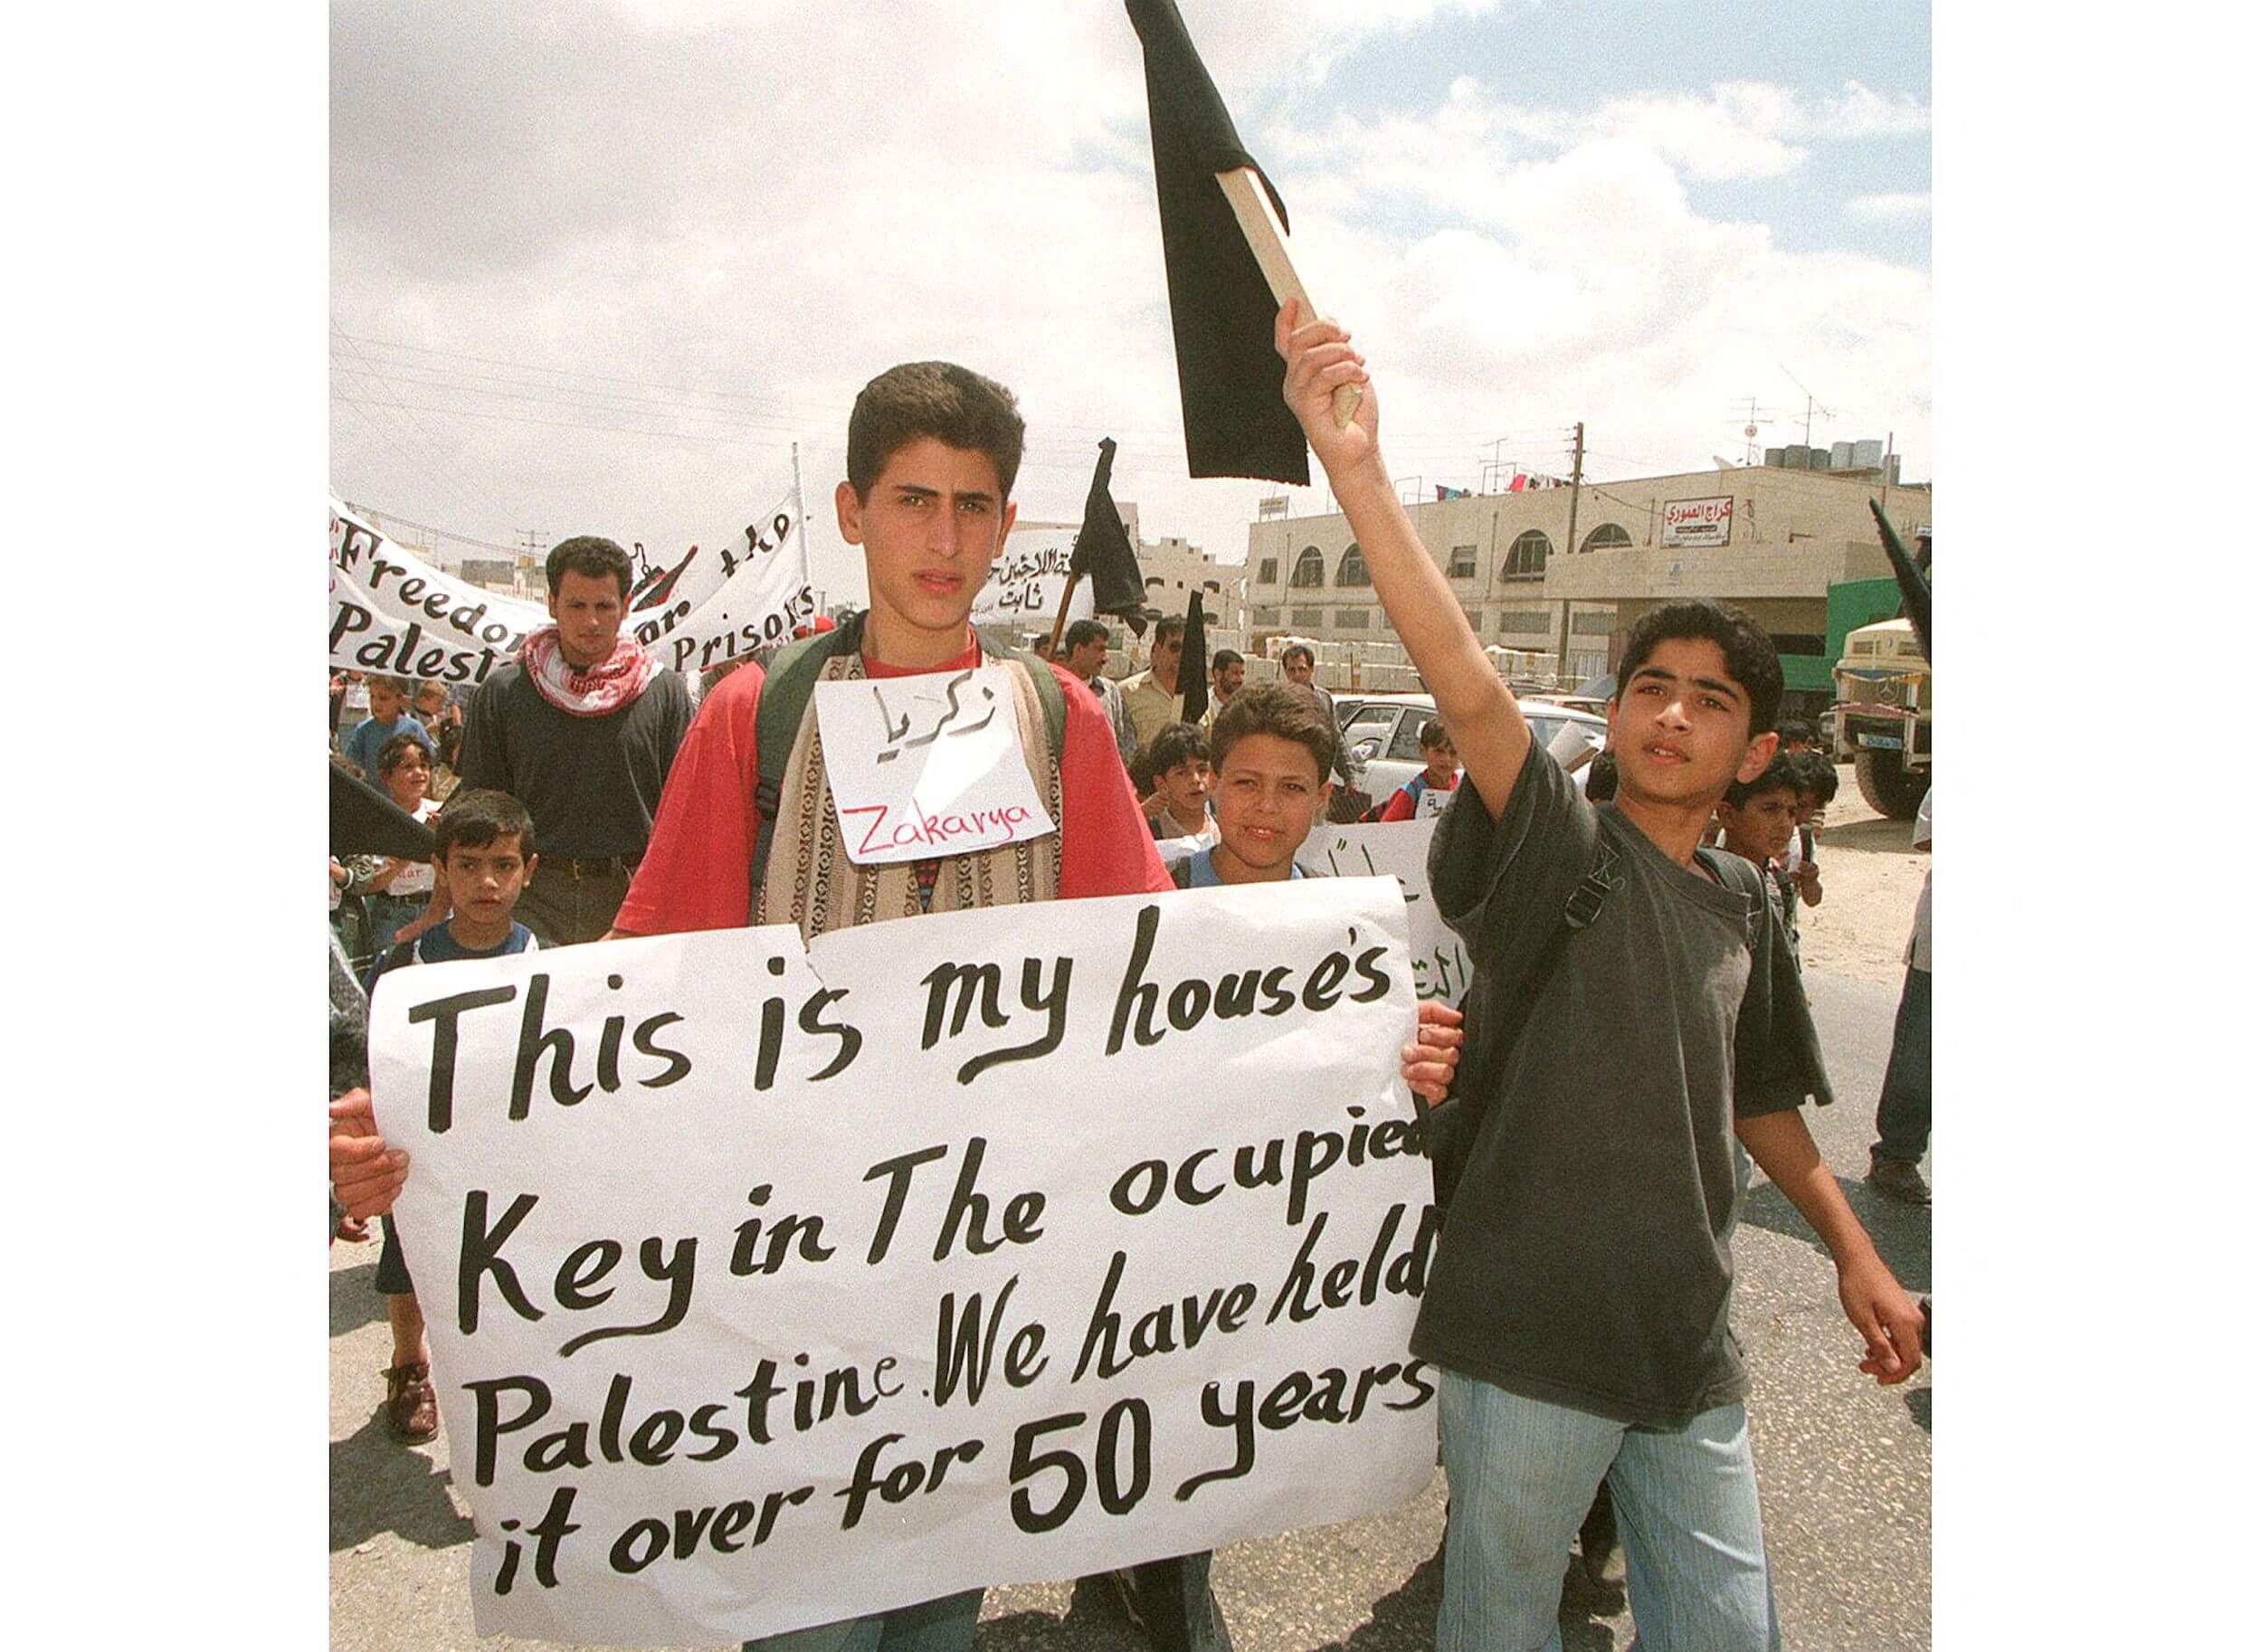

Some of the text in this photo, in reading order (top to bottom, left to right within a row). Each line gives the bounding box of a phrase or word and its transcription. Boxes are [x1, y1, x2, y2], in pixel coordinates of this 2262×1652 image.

[329, 601, 512, 683] Palest
[336, 517, 527, 652] Freedo
[999, 583, 1043, 613] ثابت
[873, 668, 995, 764] زكريا
[841, 796, 1031, 856] Zakarya
[409, 905, 1391, 1134] This is my house's
[458, 1190, 699, 1358] Key
[729, 1183, 836, 1277] in
[862, 1136, 1046, 1266] The
[934, 1274, 1050, 1408] We
[1070, 1250, 1258, 1384] have
[1265, 1203, 1442, 1325] held
[494, 1360, 1437, 1597] it over for 50 years
